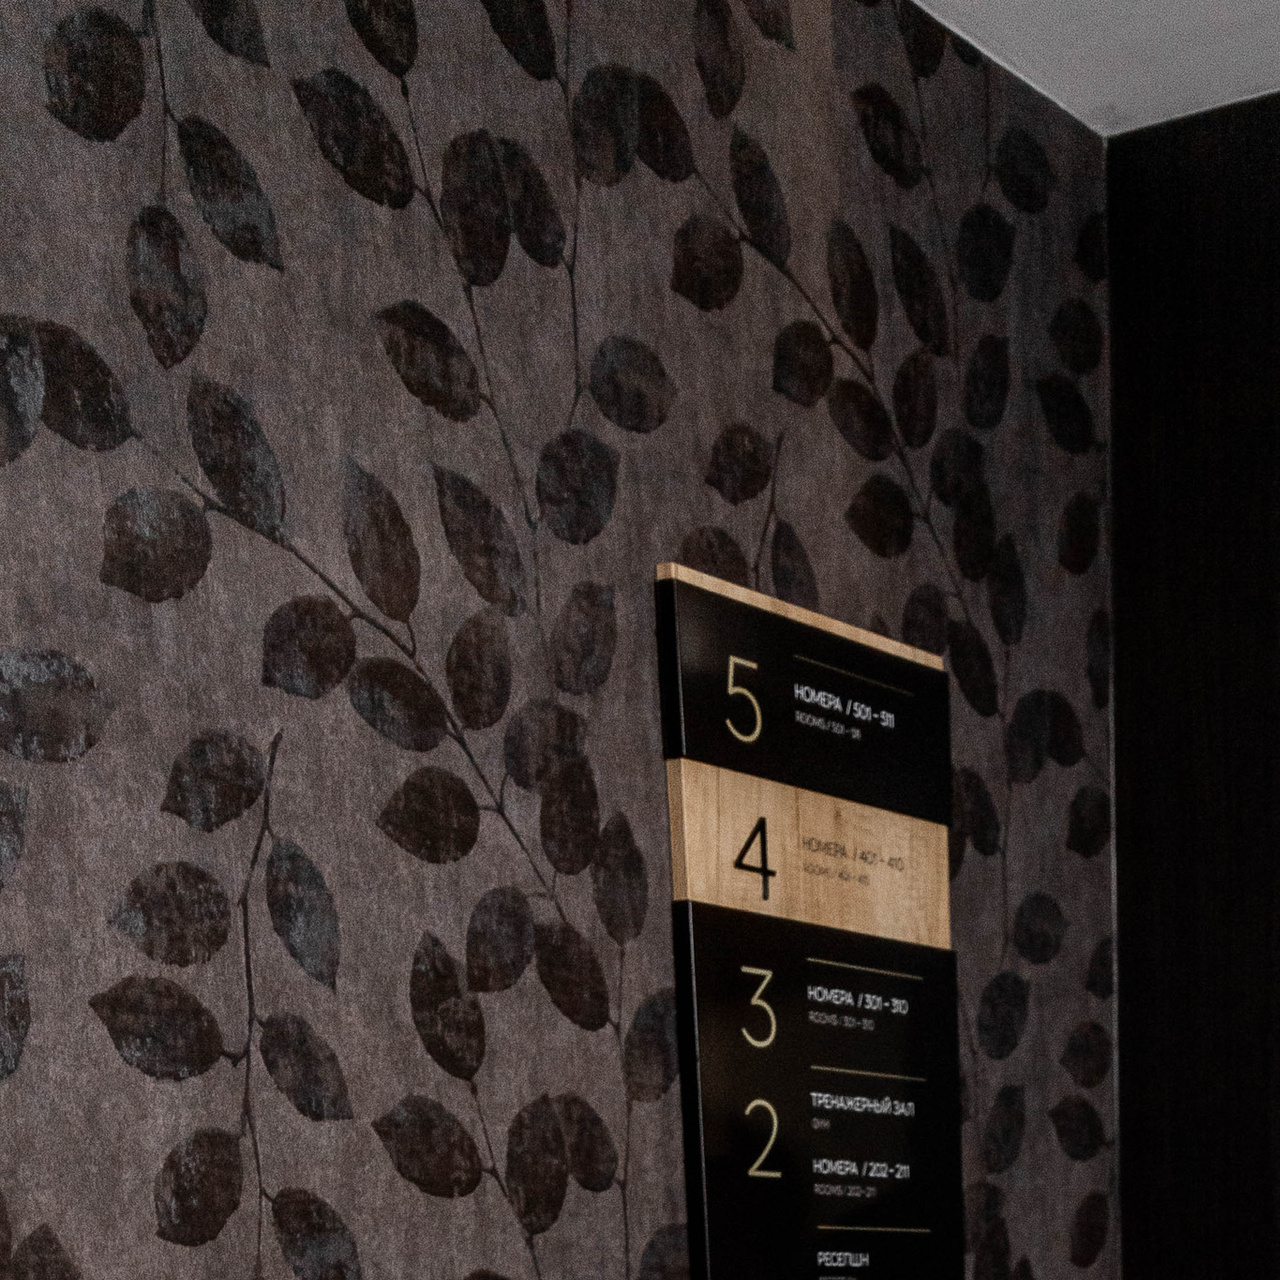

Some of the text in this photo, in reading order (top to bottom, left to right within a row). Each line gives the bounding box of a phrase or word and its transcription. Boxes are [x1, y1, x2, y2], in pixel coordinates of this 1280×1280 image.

[725, 655, 762, 743] 5
[733, 816, 776, 901] 4
[740, 965, 777, 1048] 3
[744, 1099, 782, 1179] 2
